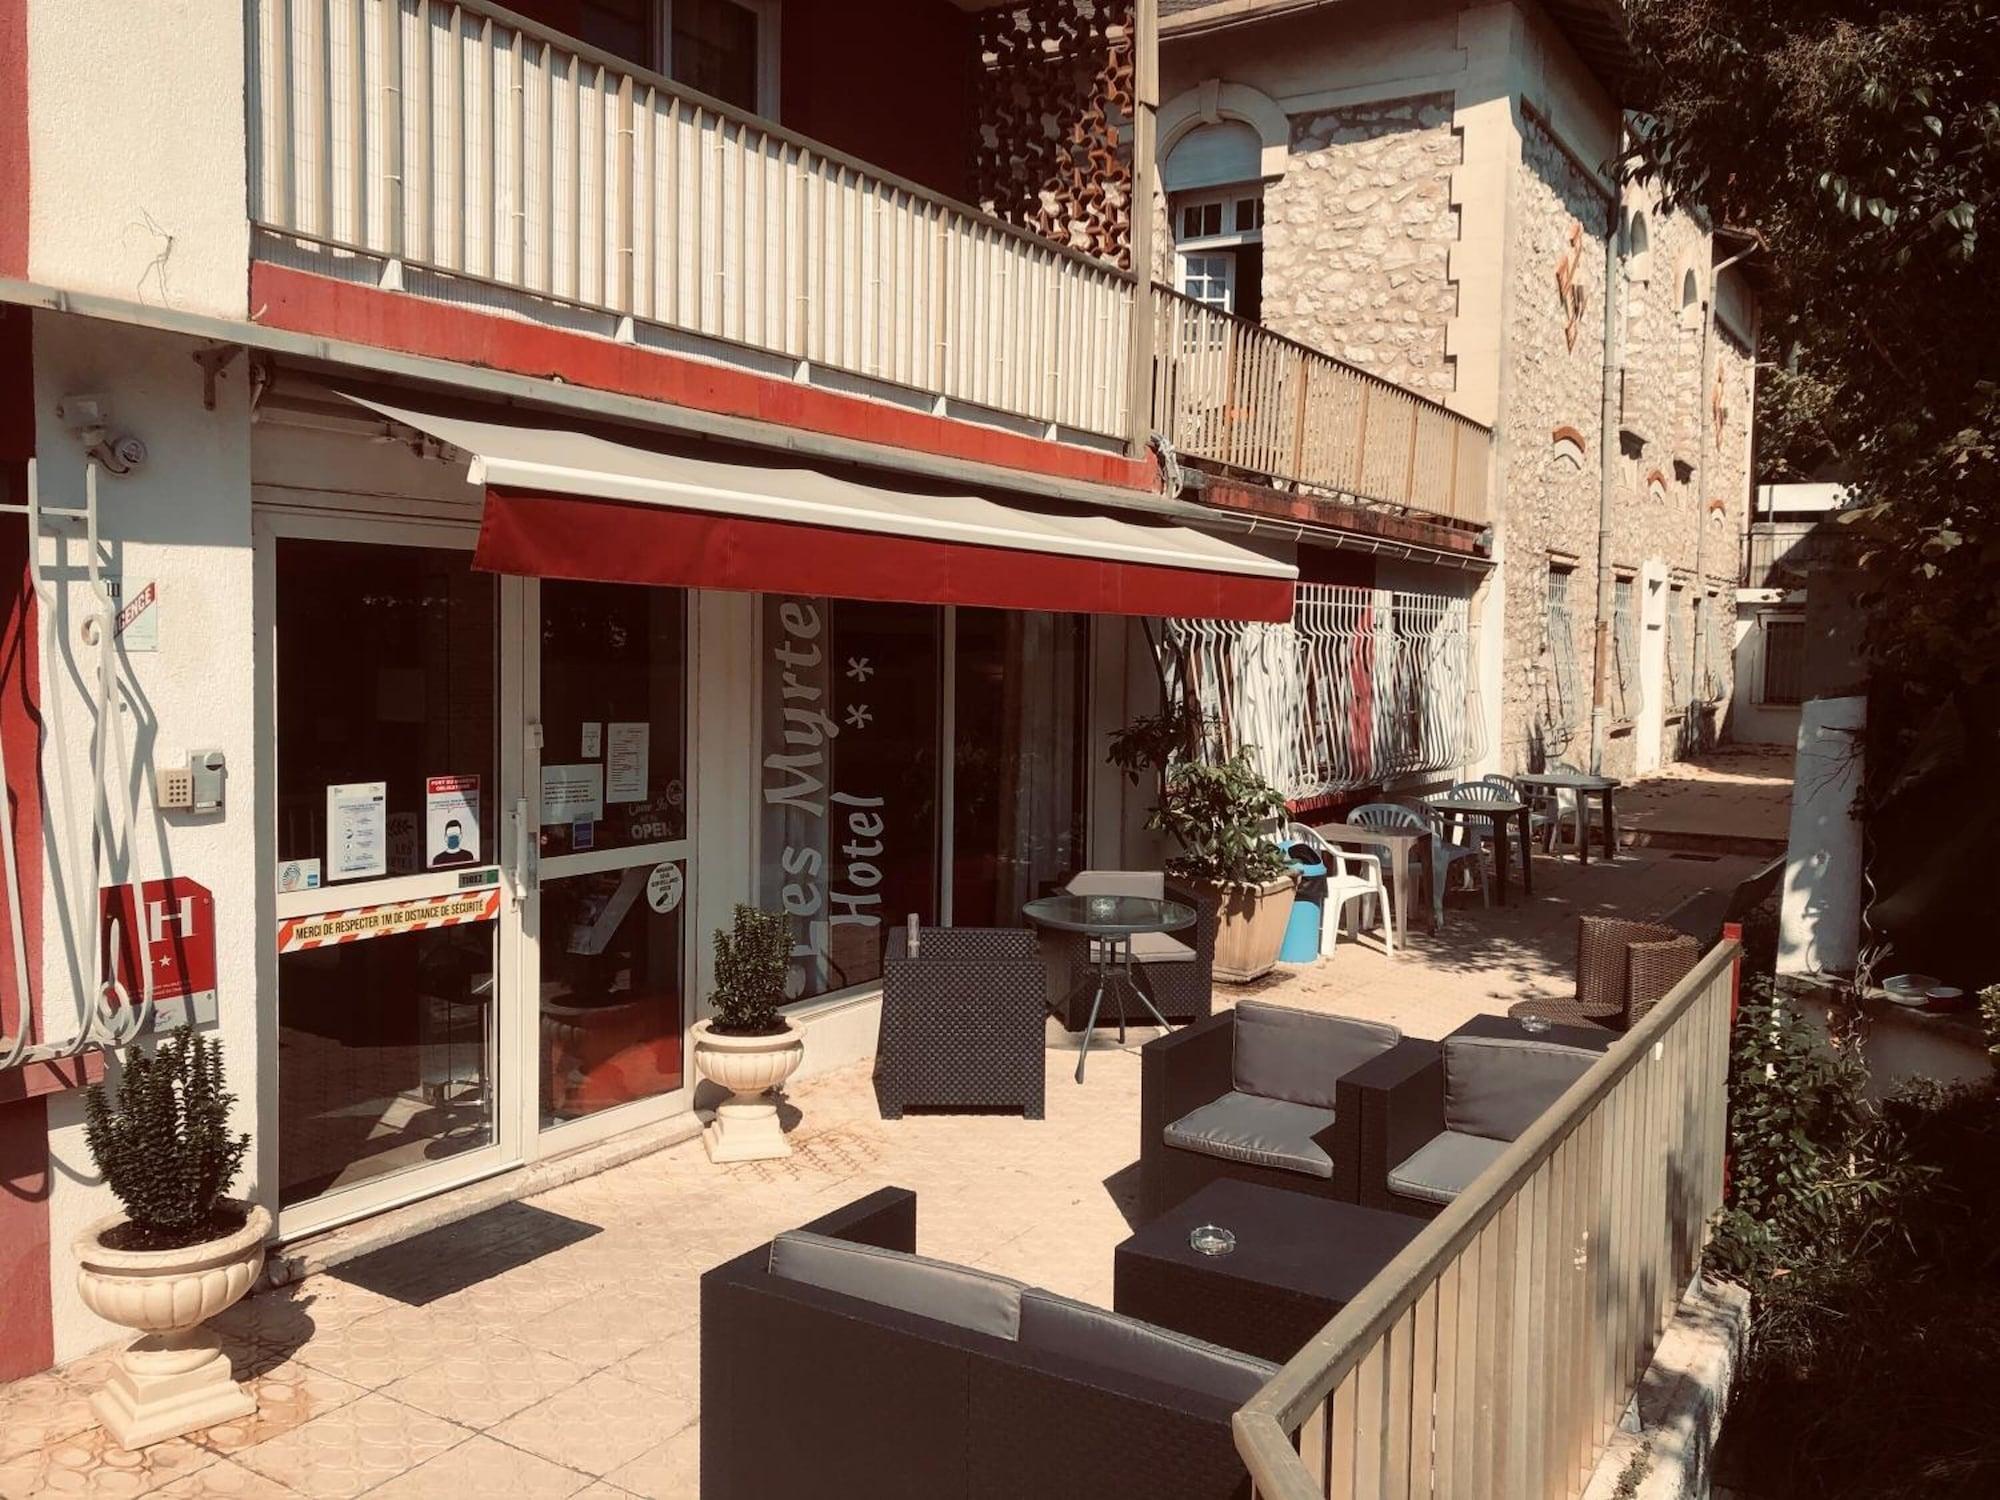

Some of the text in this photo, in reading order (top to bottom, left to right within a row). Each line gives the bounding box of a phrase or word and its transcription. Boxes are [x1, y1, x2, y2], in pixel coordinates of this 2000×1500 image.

[763, 589, 840, 1000] Les Myrte
[829, 791, 885, 927] Hotel
[144, 895, 198, 943] H
[296, 898, 484, 940] MERCI DE RESPECTER 1M DE DISTANCE DE SÉCURITÉ
